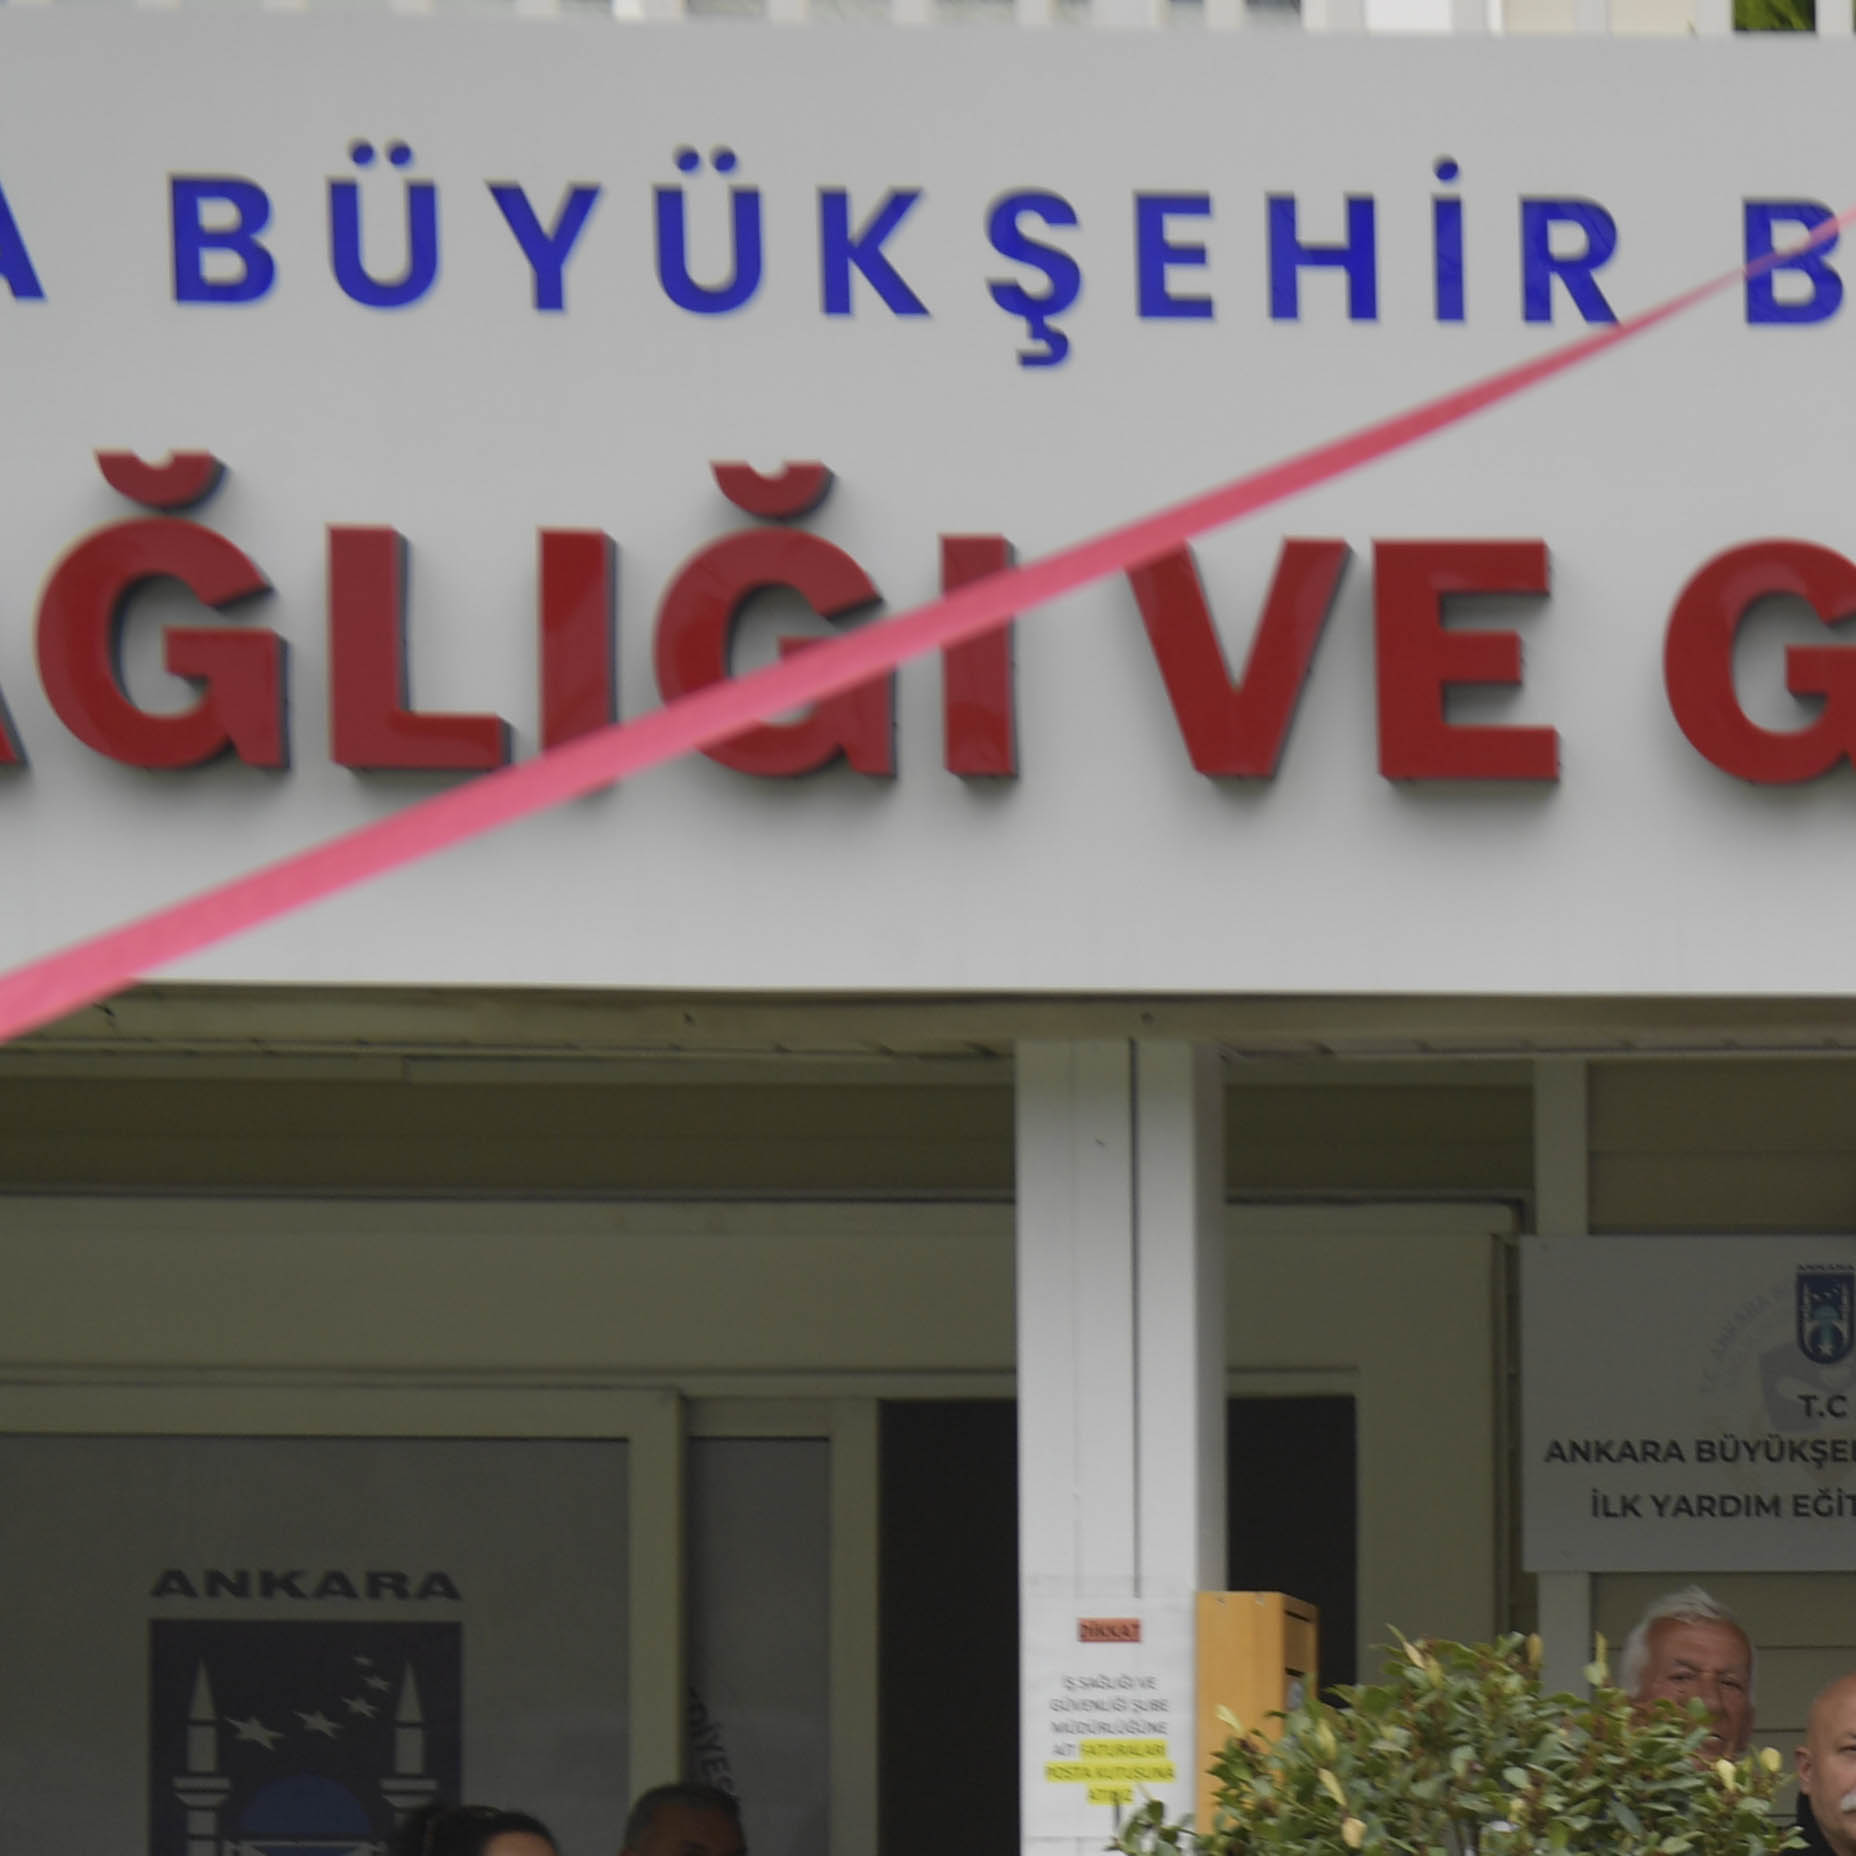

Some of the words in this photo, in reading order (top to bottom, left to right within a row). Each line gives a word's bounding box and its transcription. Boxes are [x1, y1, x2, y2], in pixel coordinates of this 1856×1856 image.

[172, 143, 1618, 368] BÜYÜKŞEHİR
[0, 450, 1030, 775] ĞLIĞI
[1126, 540, 1560, 782] VE
[1543, 1439, 1686, 1463] ANKARA
[1591, 1487, 1641, 1518] İLK
[1650, 1494, 1783, 1518] YARDIM
[150, 1568, 462, 1600] ANKARA
